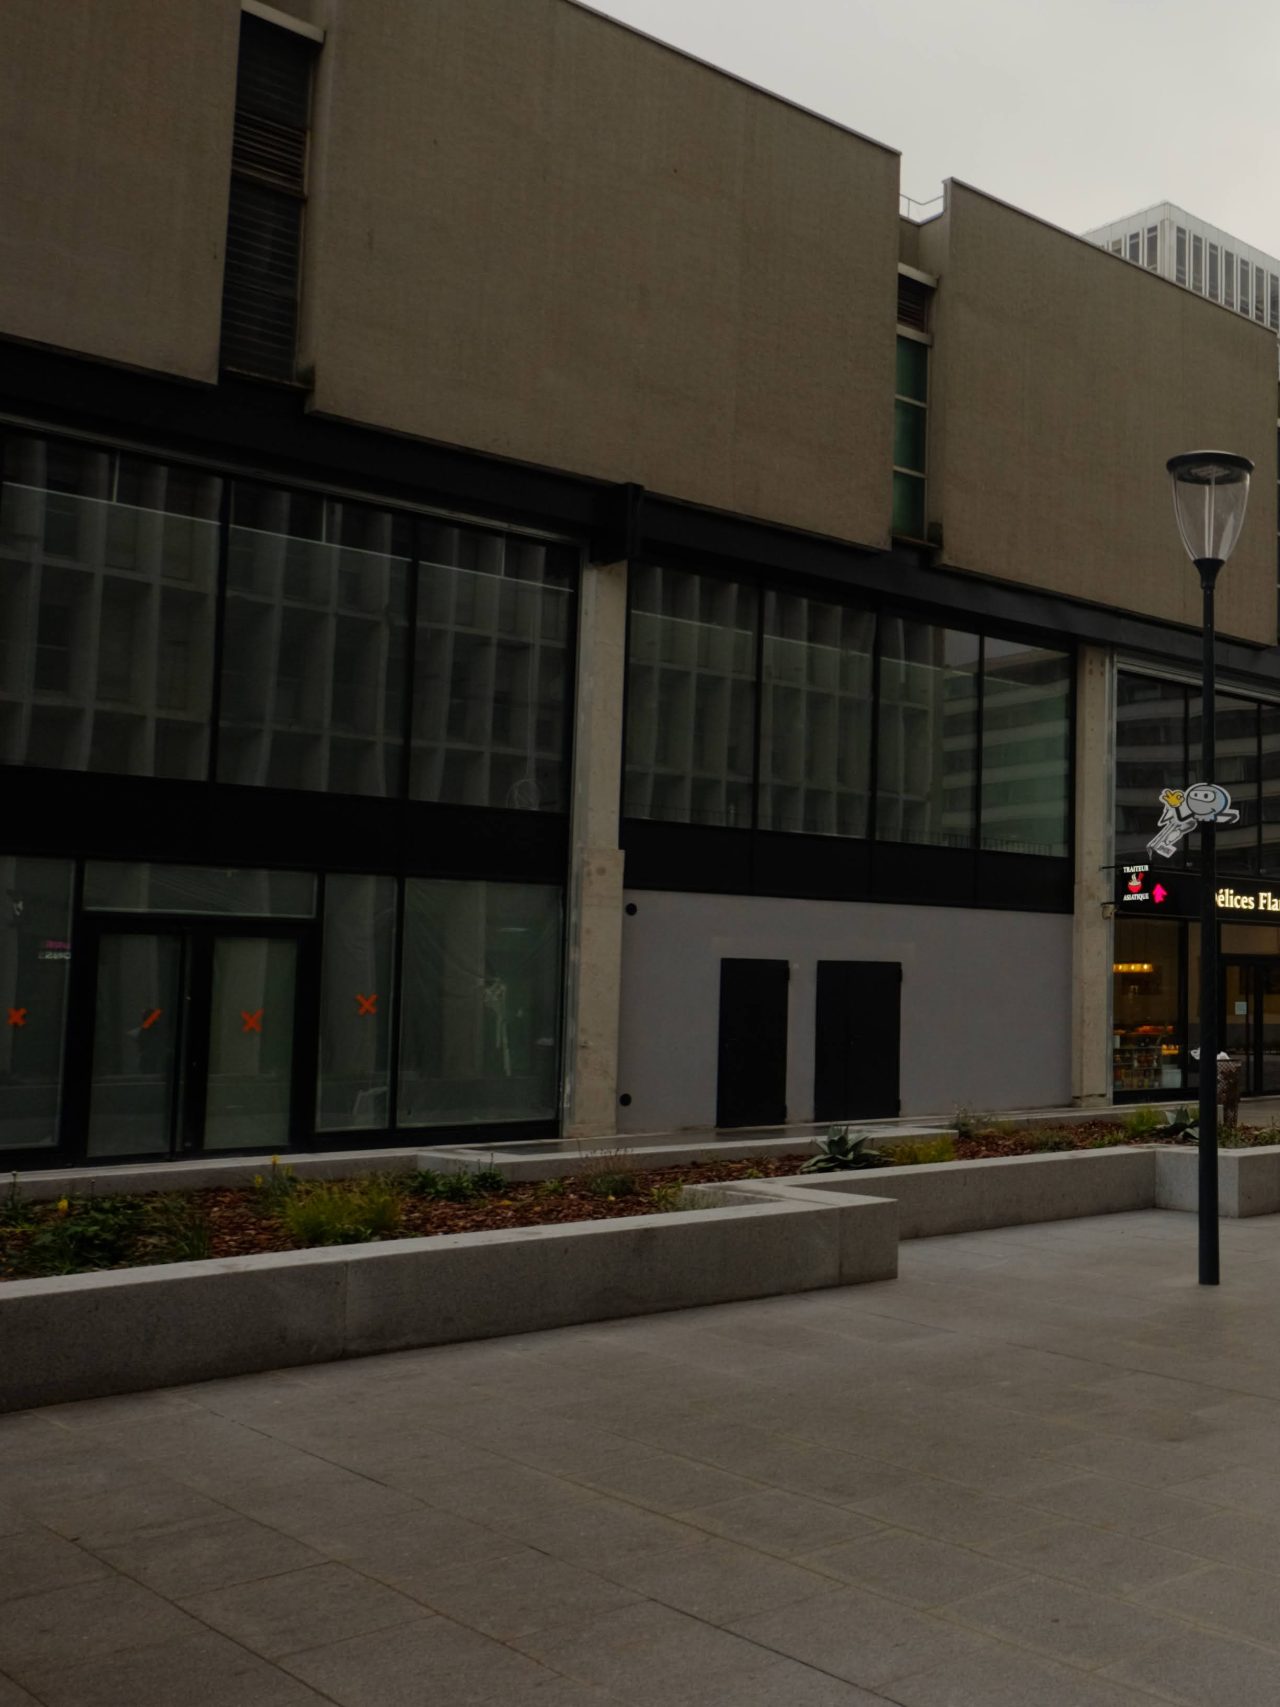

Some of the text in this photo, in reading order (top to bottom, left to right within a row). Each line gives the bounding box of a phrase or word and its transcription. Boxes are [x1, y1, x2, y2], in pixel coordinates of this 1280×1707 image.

[1123, 865, 1149, 873] TRAITEUR
[1123, 893, 1149, 901] ASIATIQUE
[1215, 888, 1255, 910] élices
